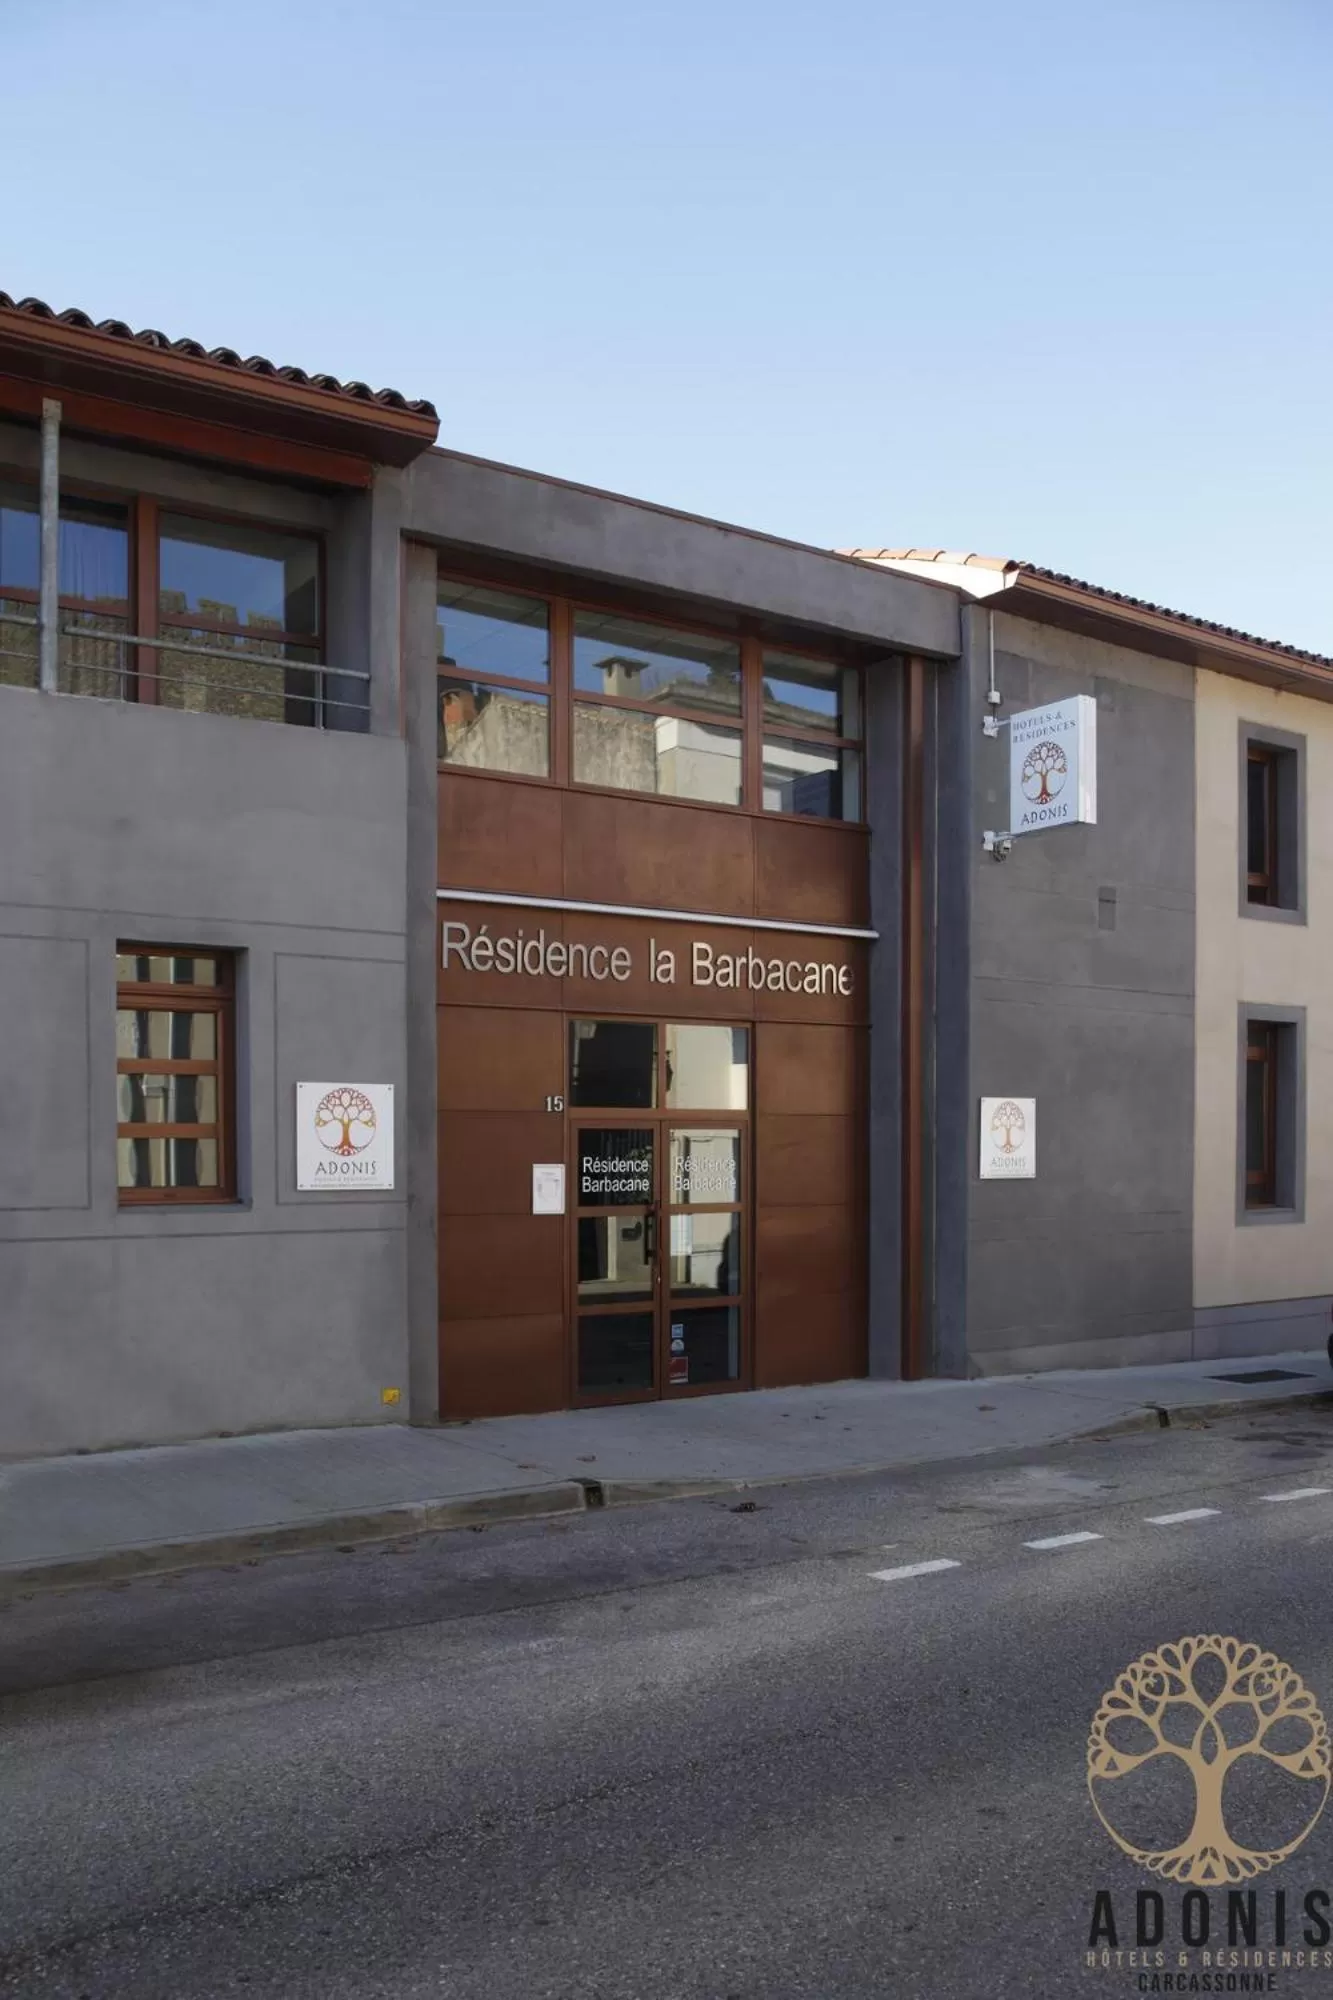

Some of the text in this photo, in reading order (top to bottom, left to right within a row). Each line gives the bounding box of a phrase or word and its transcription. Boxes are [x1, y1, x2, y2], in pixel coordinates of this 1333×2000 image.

[1021, 804, 1067, 825] ADONIS
[441, 921, 853, 996] Résidence la Barbacane
[545, 1095, 563, 1112] 15
[316, 1160, 377, 1175] ADONIS
[582, 1156, 649, 1173] Résidence
[675, 1156, 736, 1172] Résidence
[990, 1157, 1026, 1169] ADONIS
[582, 1176, 649, 1193] Barbacane
[674, 1175, 737, 1192] Barbacane
